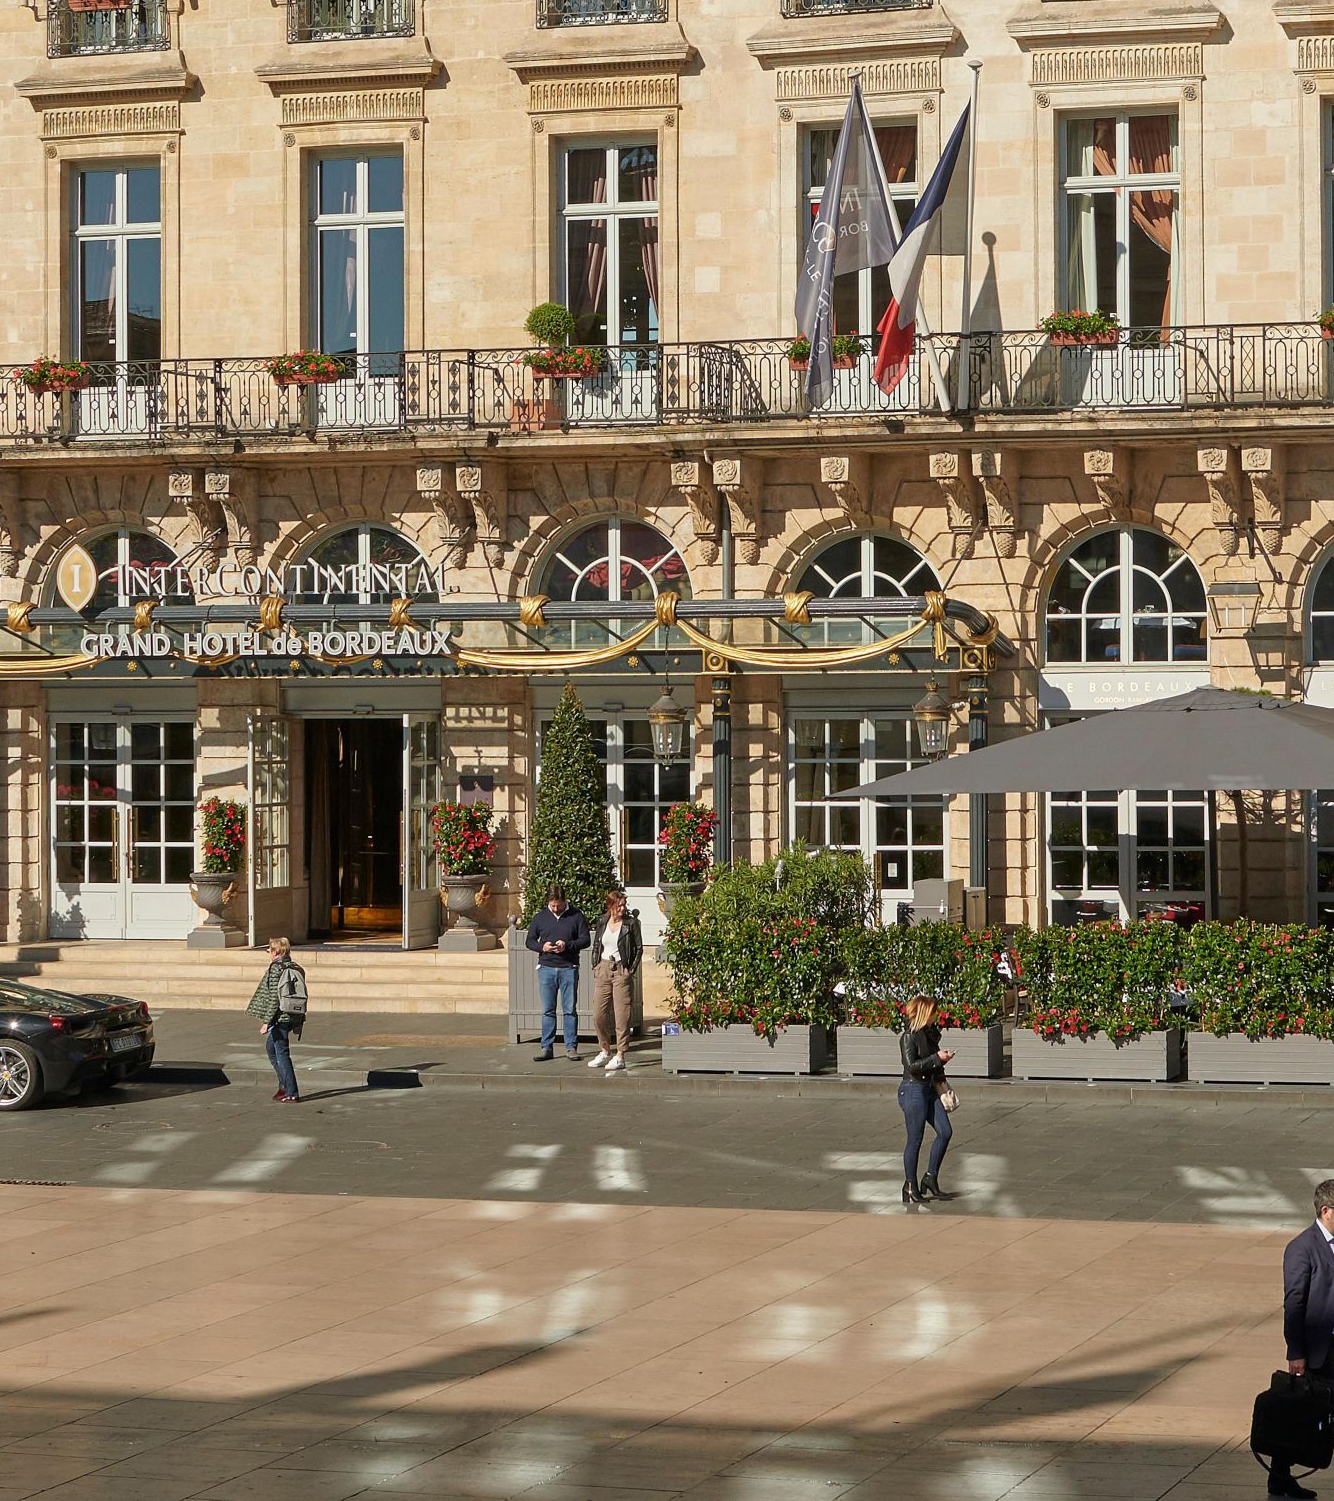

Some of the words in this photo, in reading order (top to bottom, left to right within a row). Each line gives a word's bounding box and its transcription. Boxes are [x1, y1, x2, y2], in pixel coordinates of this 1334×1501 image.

[80, 633, 171, 657] GRAND
[184, 632, 267, 656] HOTEL
[272, 632, 302, 656] de
[308, 631, 452, 656] BORDEAUX
[1089, 682, 1193, 693] BORDEAUX
